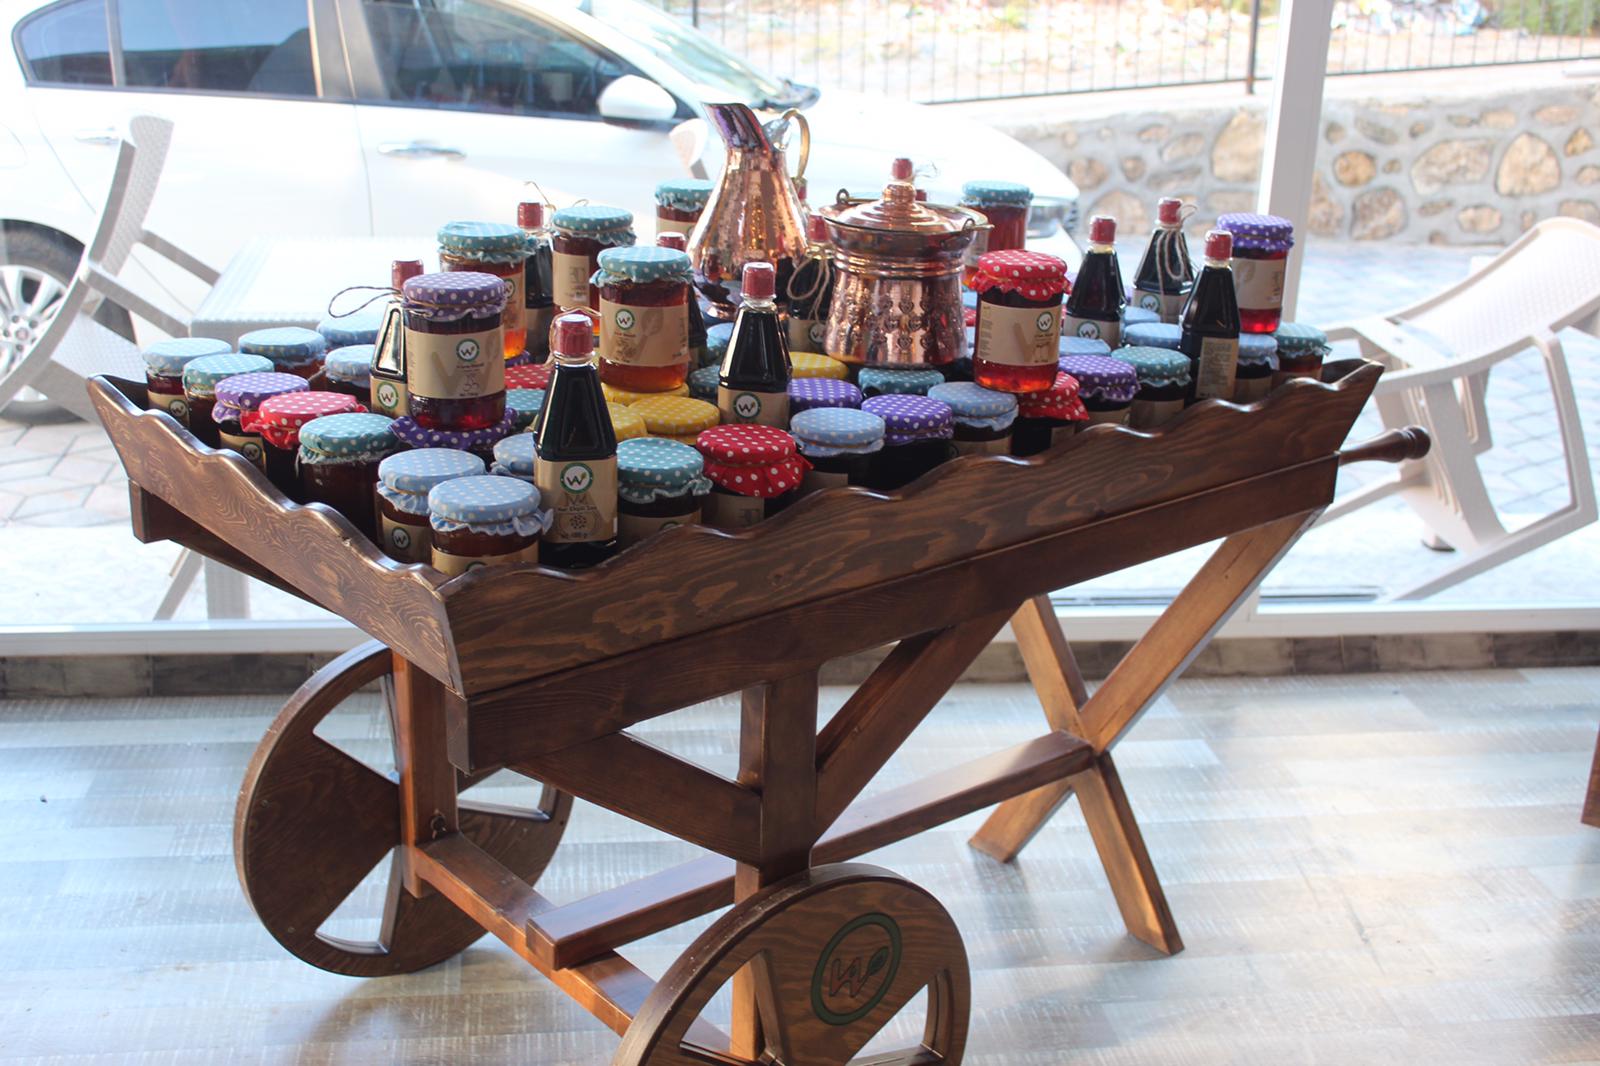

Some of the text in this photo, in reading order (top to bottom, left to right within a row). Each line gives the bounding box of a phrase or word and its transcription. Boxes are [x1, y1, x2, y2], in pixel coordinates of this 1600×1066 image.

[461, 346, 475, 356] W
[381, 392, 393, 402] W
[738, 402, 755, 413] W
[566, 472, 586, 486] W
